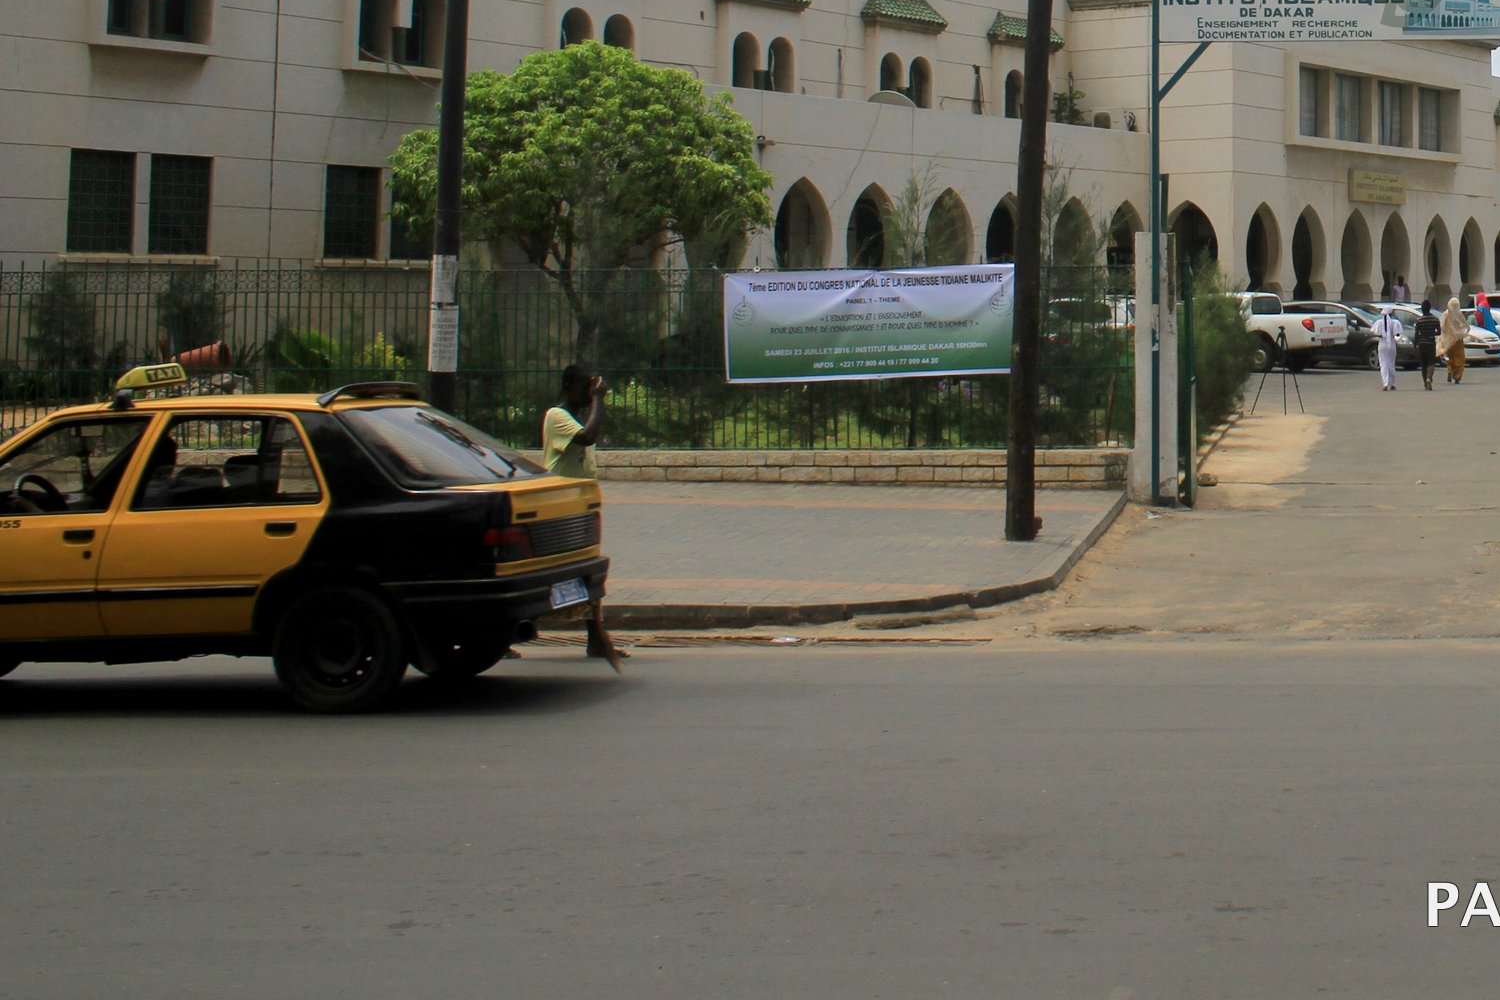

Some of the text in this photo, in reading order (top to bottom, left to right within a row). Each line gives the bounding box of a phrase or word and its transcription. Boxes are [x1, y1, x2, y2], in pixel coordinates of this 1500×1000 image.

[1239, 7, 1314, 18] DE DAKAR
[1197, 17, 1359, 29] ENSEIGNEMENT RECHERCHE
[1197, 28, 1373, 39] DOCUMENTATION ET PUBLICATION
[768, 281, 796, 292] EDITION
[797, 281, 808, 291] DU
[809, 280, 844, 291] CONGRES
[845, 278, 880, 289] NATONAL
[881, 277, 891, 288] DE
[892, 277, 902, 287] LA
[902, 276, 940, 287] JEUNESSE
[940, 274, 969, 286] TIDIANE
[970, 272, 1003, 285] MALIKITE
[803, 347, 833, 356] JUILLET
[855, 345, 887, 353] INSTITUT
[887, 343, 927, 352] ISLAMIQUE
[928, 342, 955, 350] DAKAR
[813, 361, 834, 369] INFOS
[146, 366, 181, 382] TAXI
[0, 519, 22, 529] 55
